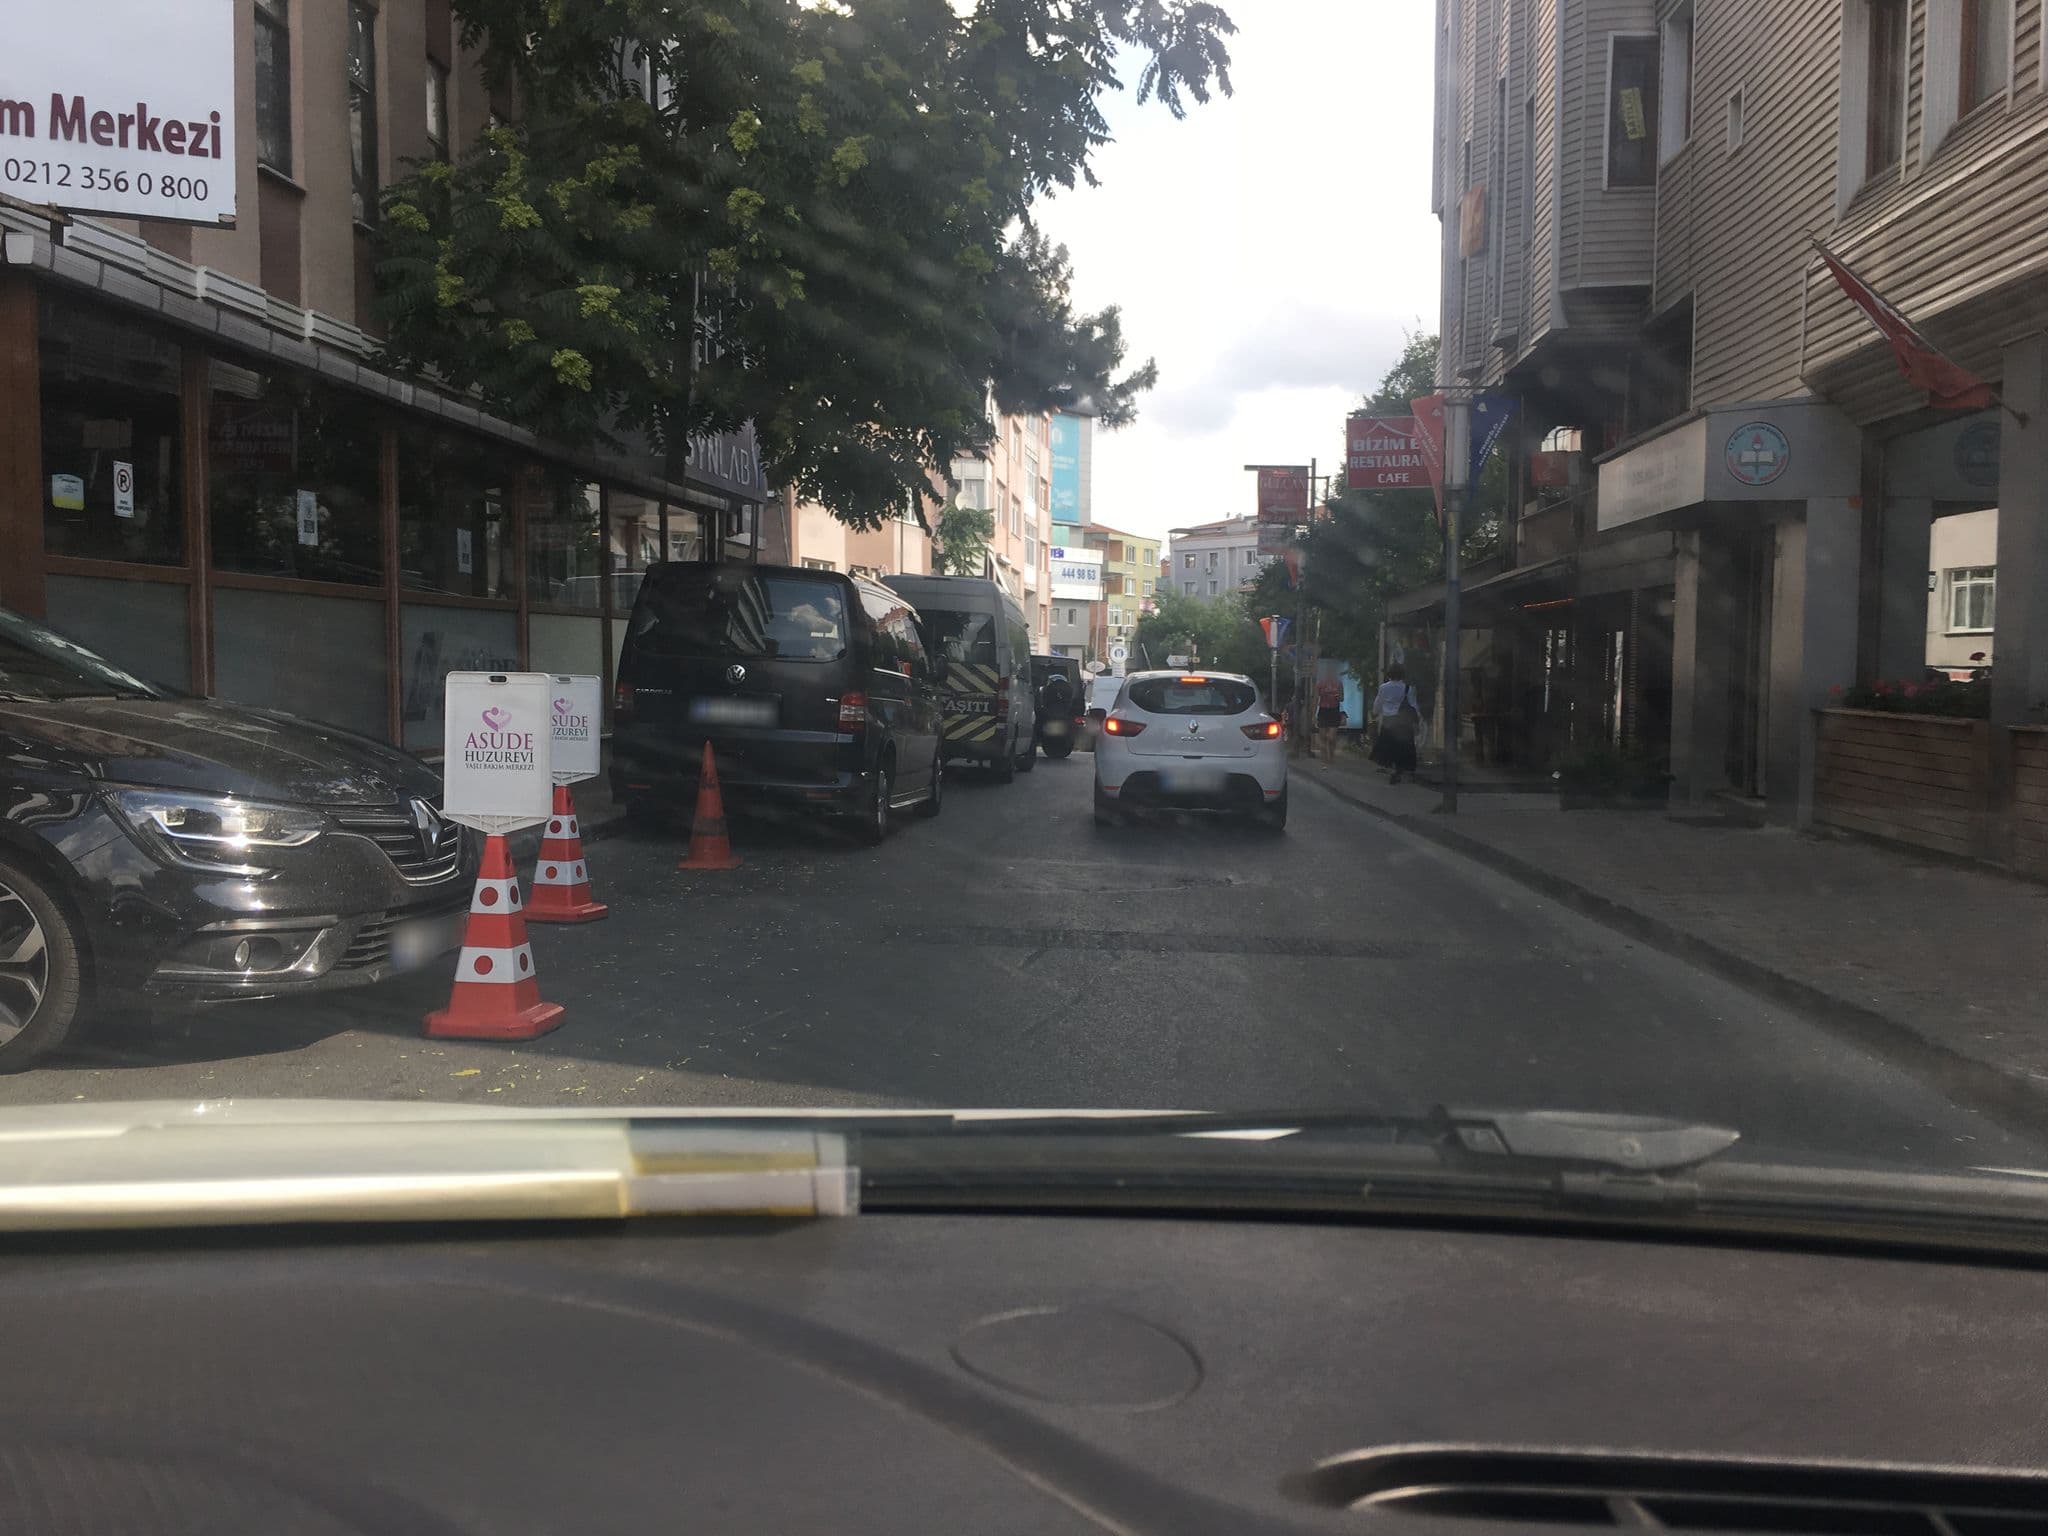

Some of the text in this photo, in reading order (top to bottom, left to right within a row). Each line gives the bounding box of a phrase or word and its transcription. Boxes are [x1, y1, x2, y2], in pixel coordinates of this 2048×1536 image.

[50, 92, 222, 159] Merkezi
[4, 158, 208, 201] 0212 356 0 800
[1352, 436, 1406, 451] BİZİM
[1350, 454, 1424, 468] RESTAURA
[1378, 472, 1409, 483] CAFE
[1062, 567, 1075, 579] 444
[943, 699, 990, 714] AŞITI
[552, 715, 588, 727] SUDE
[465, 732, 534, 750] ASUDE
[465, 750, 534, 763] HUZUREVİ
